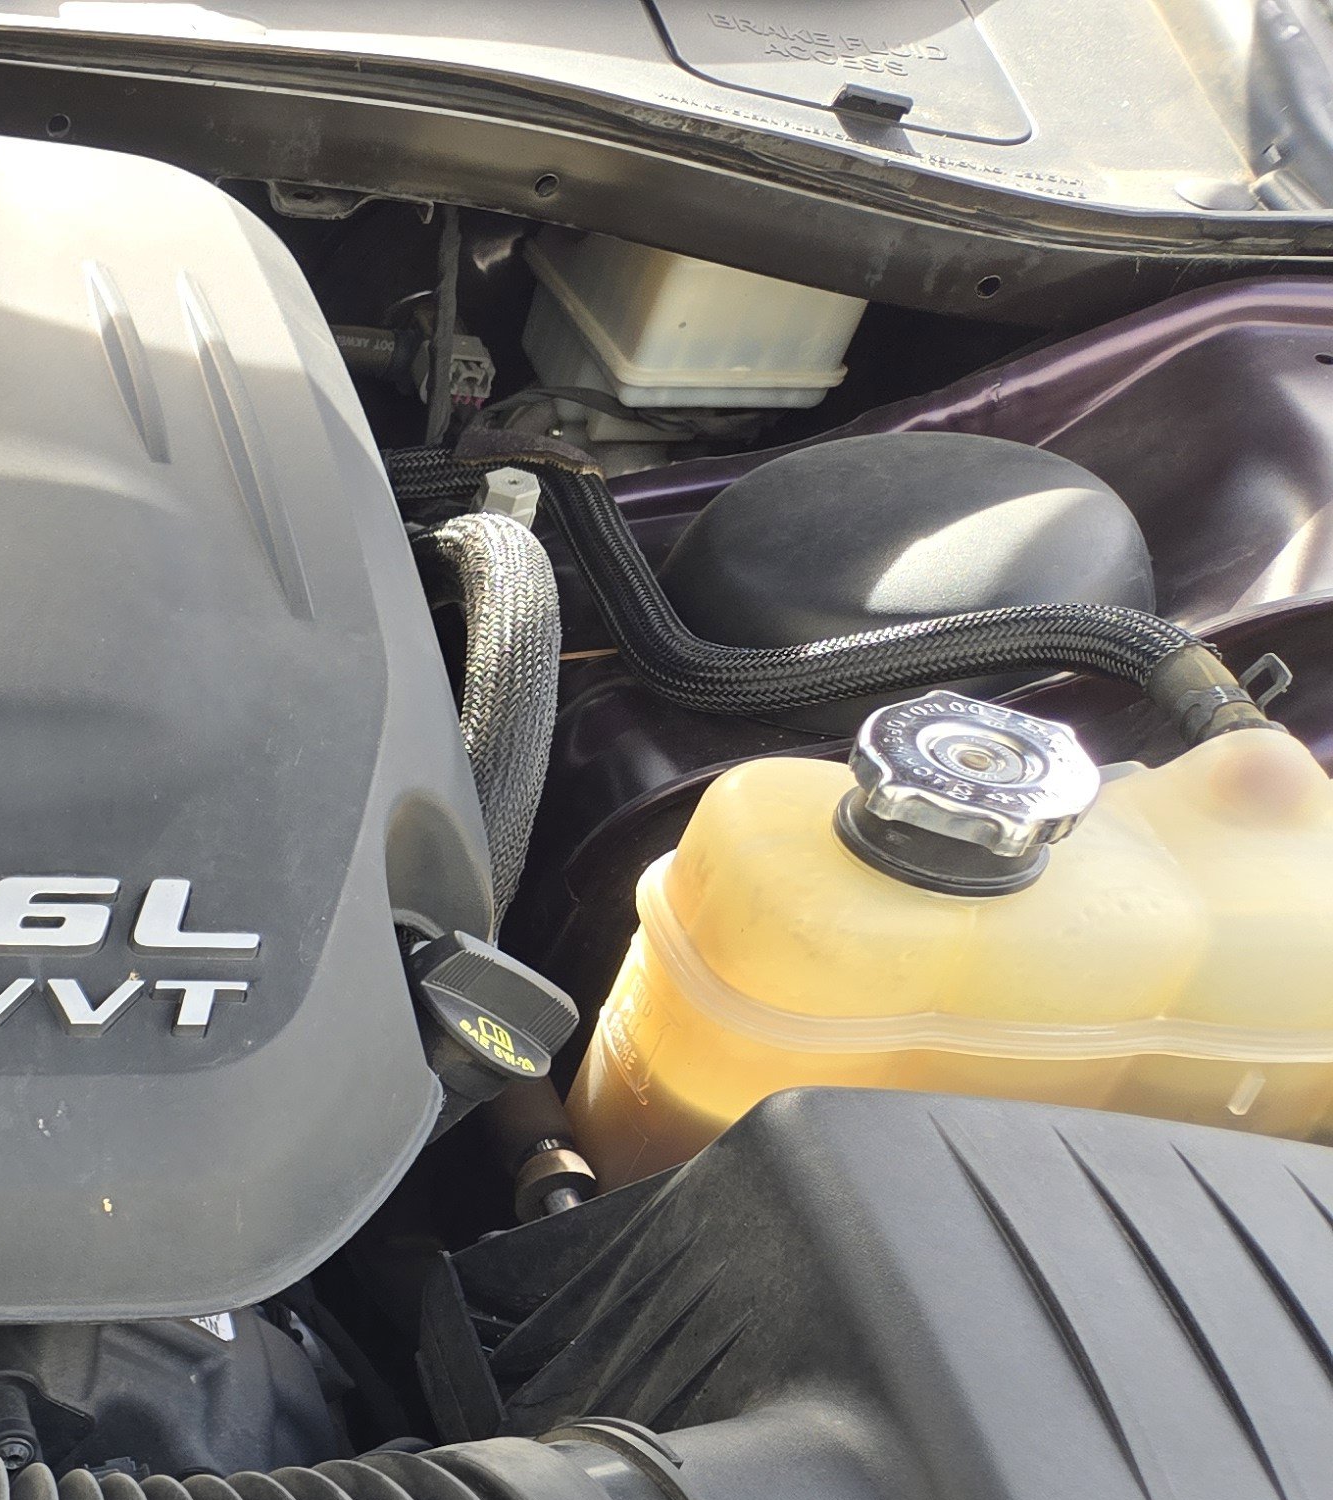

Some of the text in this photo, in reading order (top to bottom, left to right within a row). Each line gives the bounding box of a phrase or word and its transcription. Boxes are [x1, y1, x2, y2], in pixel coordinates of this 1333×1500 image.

[707, 12, 948, 61] BRAKE FLUID
[765, 43, 908, 76] ACCESS
[459, 1019, 490, 1050] SAE
